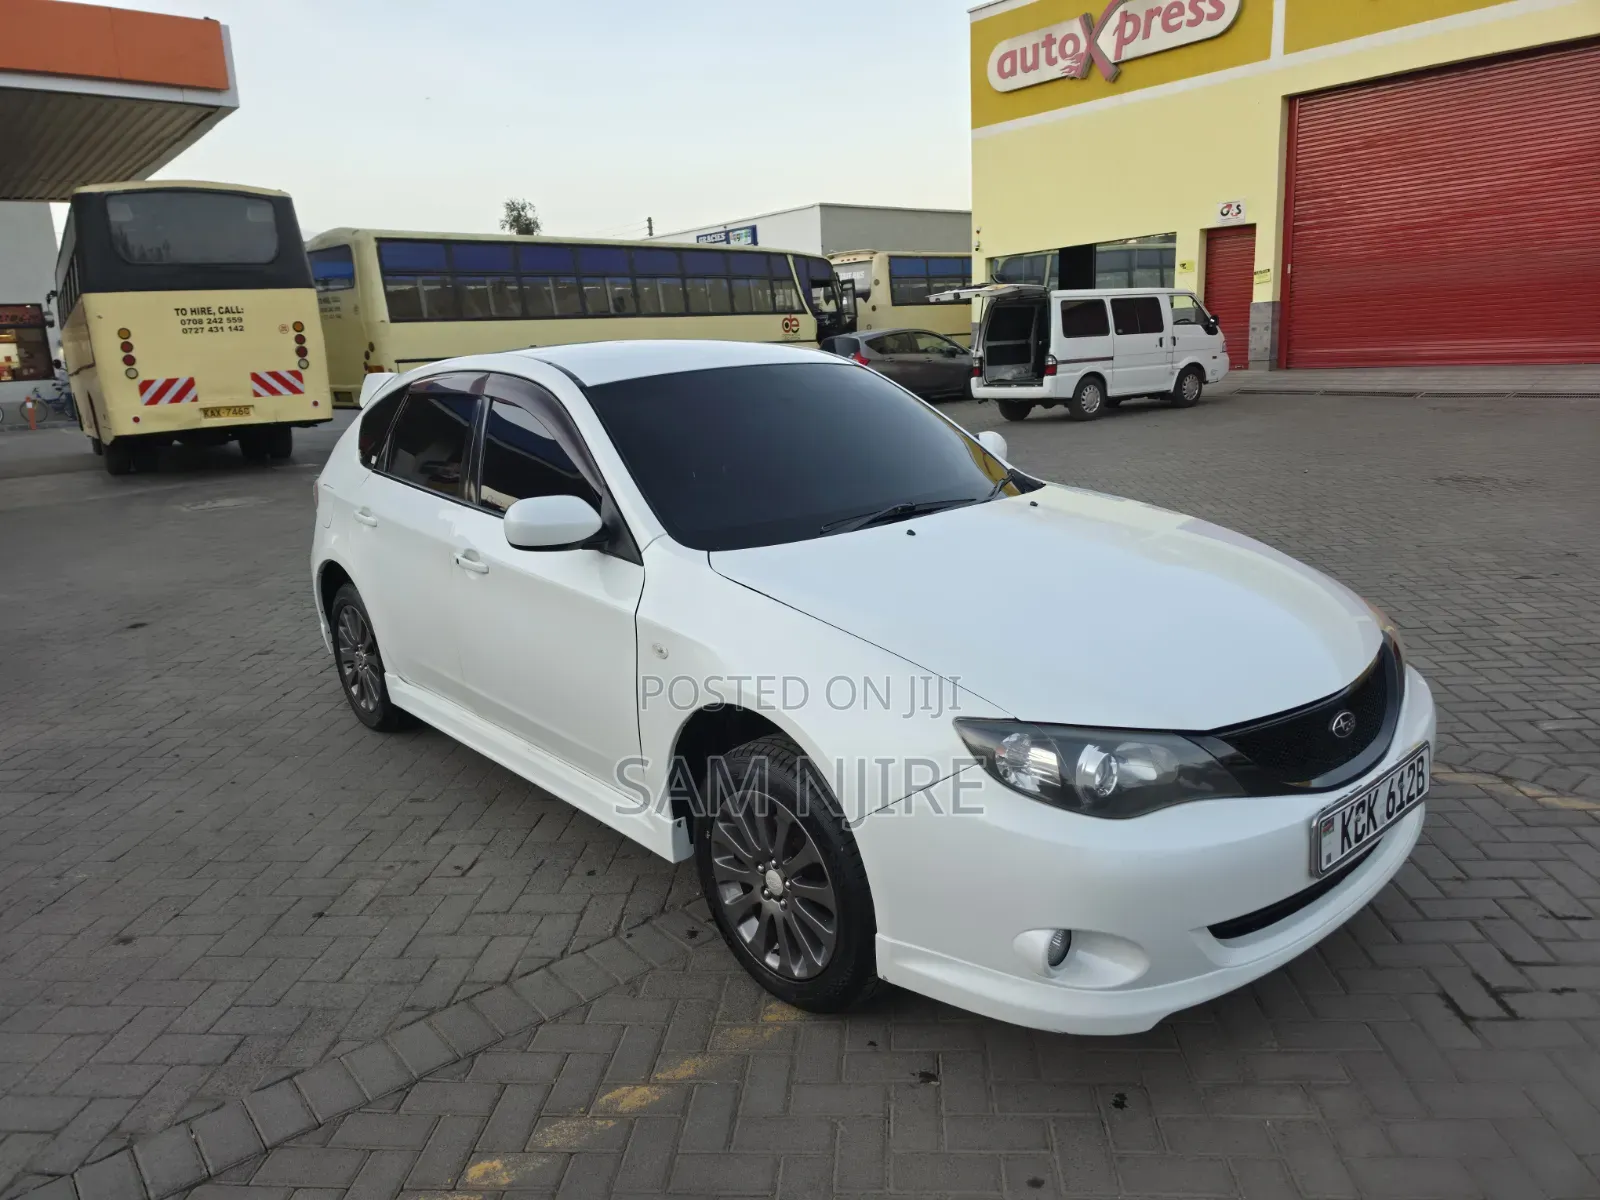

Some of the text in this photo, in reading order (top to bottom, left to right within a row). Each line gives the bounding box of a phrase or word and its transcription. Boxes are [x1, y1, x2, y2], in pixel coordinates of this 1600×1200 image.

[1220, 203, 1242, 217] GS
[174, 305, 244, 316] TO HIRE, CALL:
[180, 318, 204, 326] 0708
[206, 317, 224, 325] 242
[182, 324, 244, 335] 0727 431 142
[1340, 755, 1425, 856] KCK 612B
